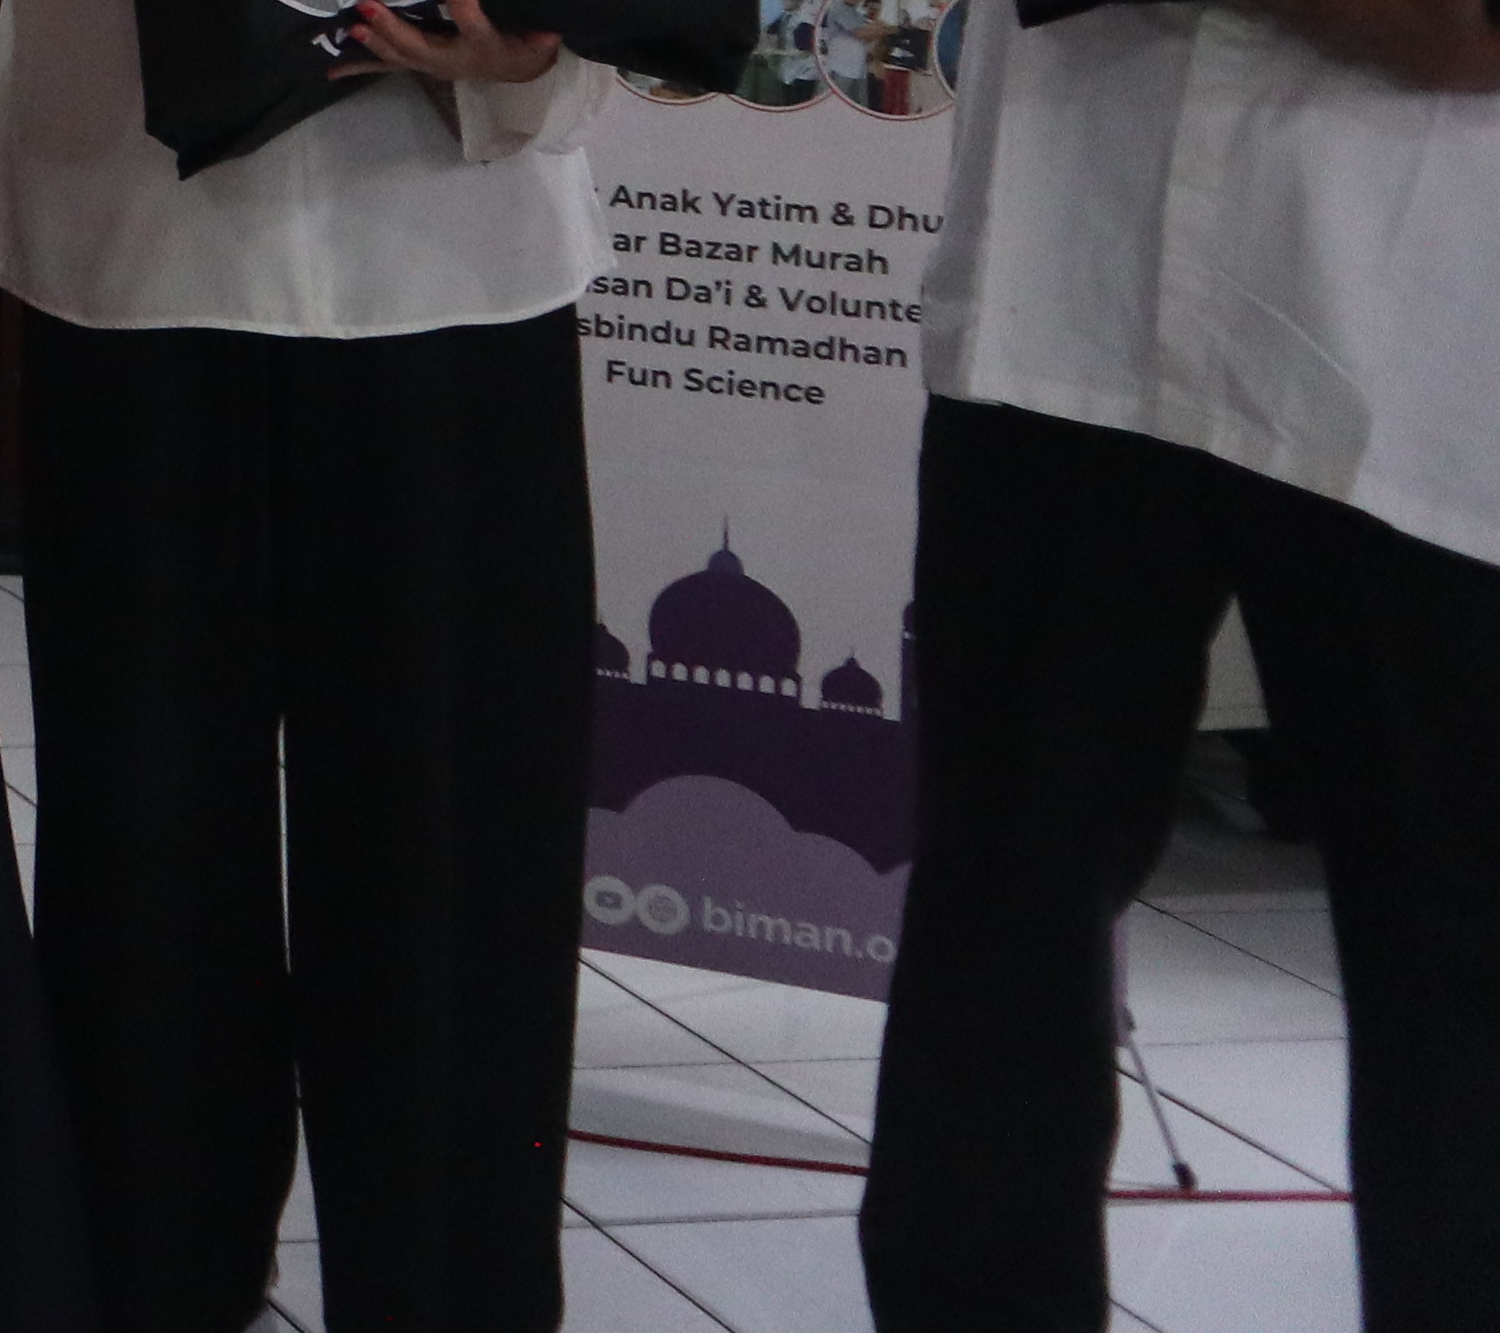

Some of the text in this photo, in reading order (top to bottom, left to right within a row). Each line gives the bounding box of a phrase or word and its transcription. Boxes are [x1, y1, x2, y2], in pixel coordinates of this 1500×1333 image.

[609, 185, 944, 235] Anak Yatim & Dhu
[659, 231, 760, 264] Bazar
[771, 241, 889, 276] Murah
[744, 285, 768, 309] &
[708, 325, 909, 369] Ramadhan
[606, 359, 825, 405] Fun Science
[702, 895, 897, 965] biman.o
